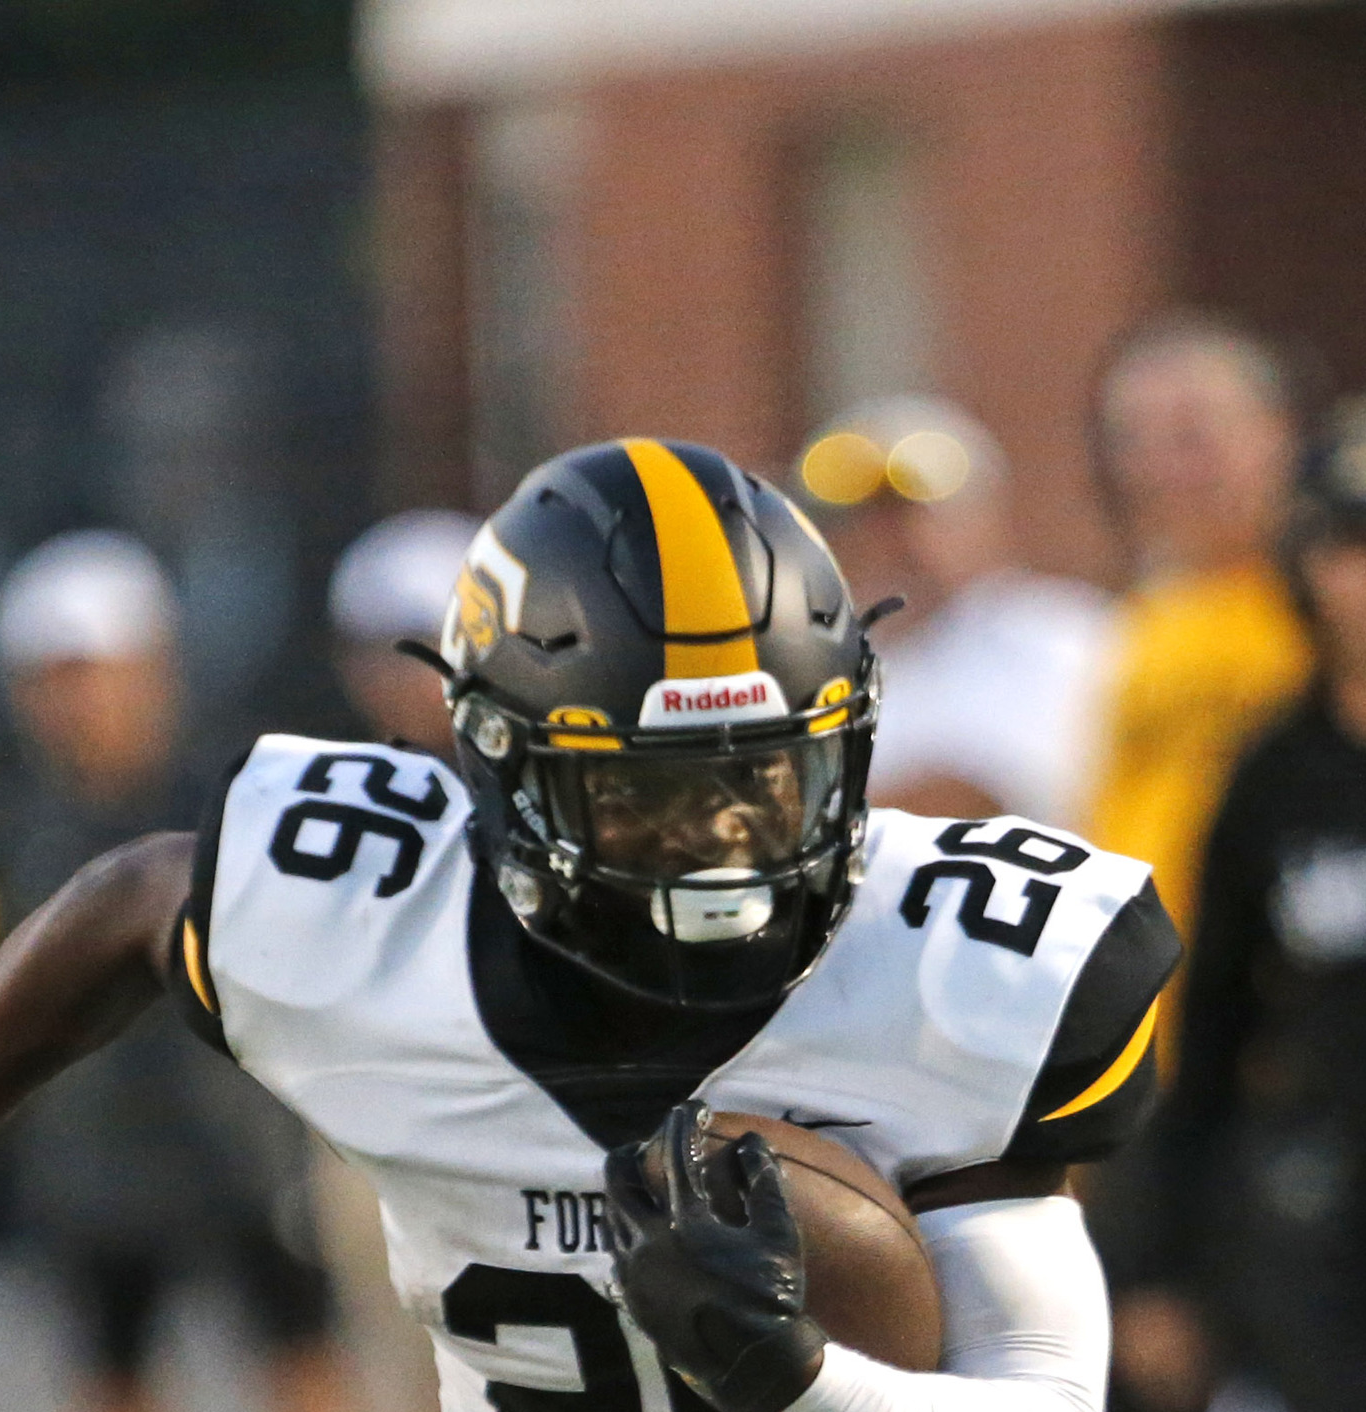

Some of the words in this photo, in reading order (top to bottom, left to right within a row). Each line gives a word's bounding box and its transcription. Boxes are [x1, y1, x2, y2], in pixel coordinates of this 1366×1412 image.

[662, 684, 767, 712] Riddell
[269, 753, 450, 899] 26
[898, 821, 1091, 957] 26
[520, 1189, 615, 1254] FOR
